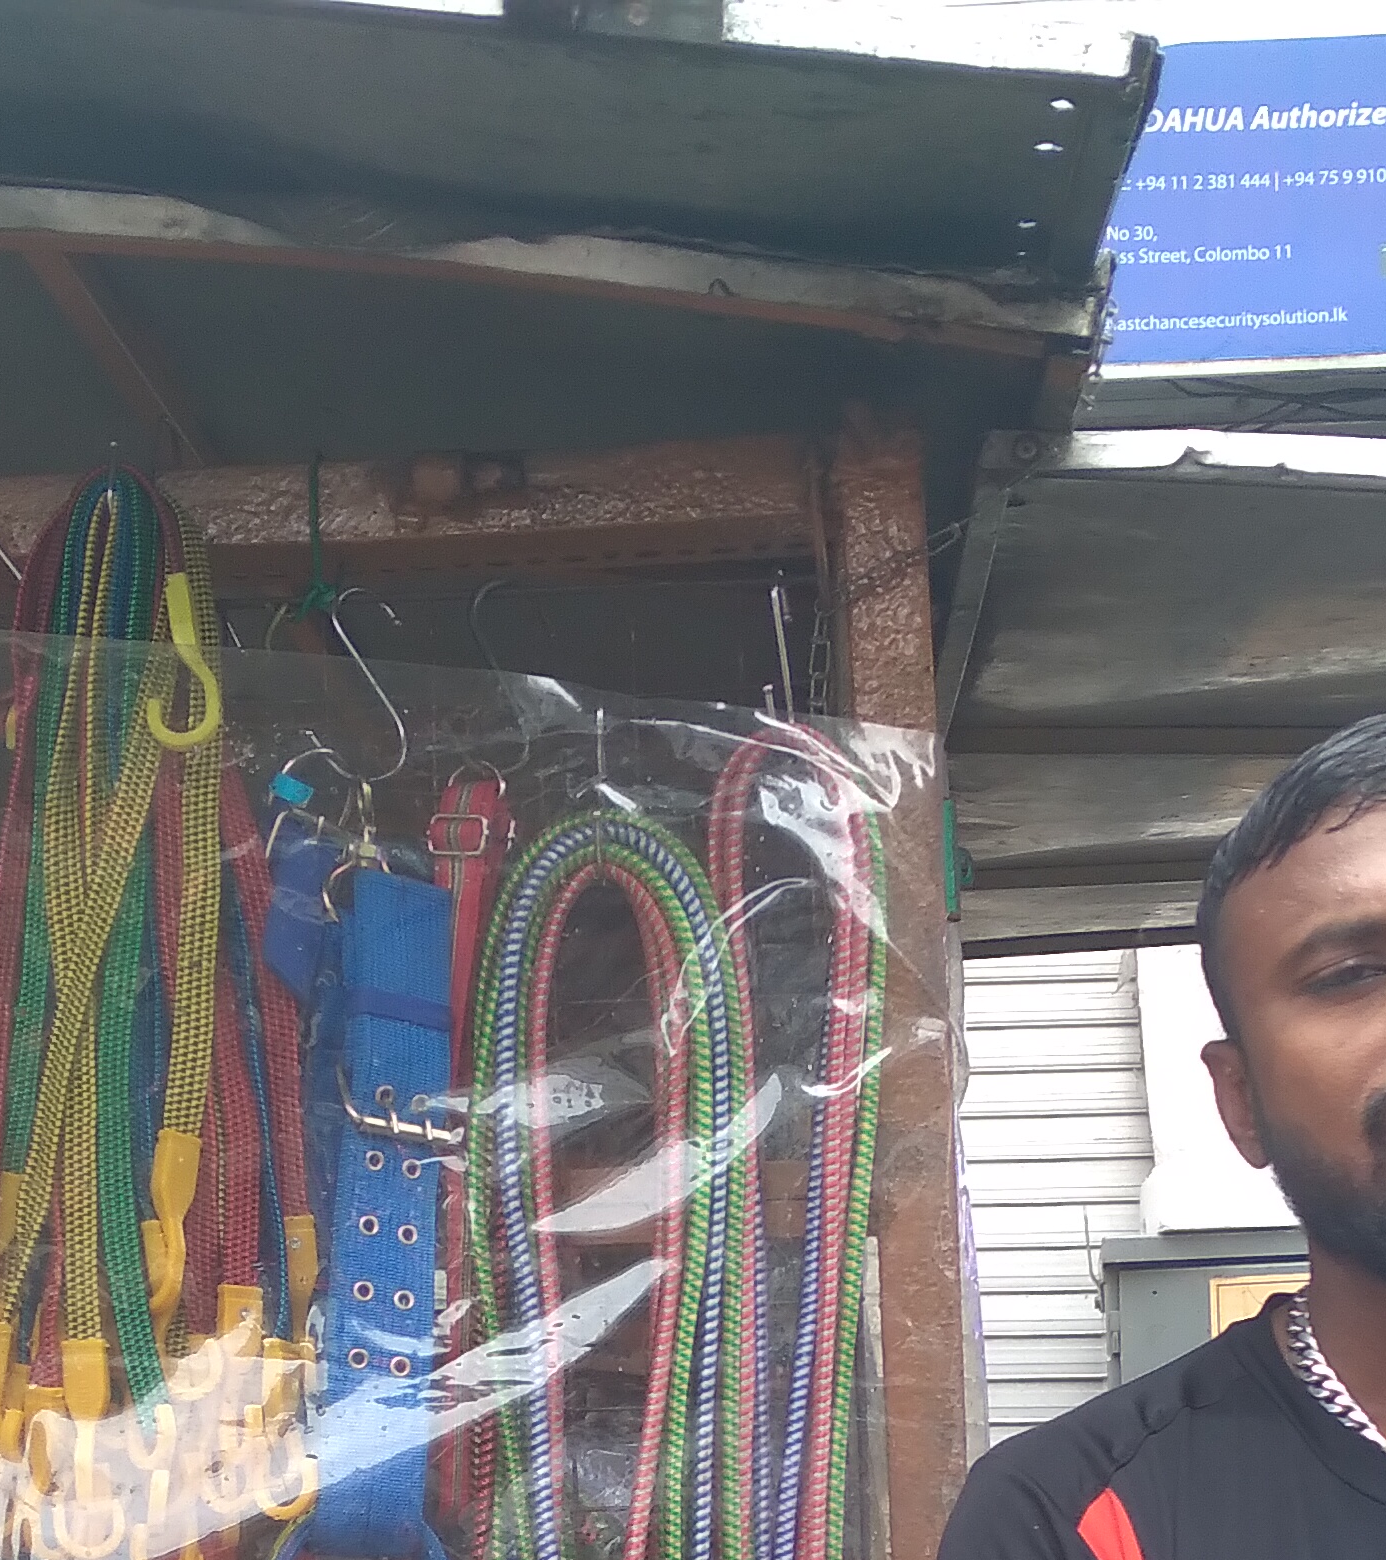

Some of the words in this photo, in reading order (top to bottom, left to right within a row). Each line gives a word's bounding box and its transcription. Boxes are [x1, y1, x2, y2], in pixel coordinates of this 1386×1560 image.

[1144, 106, 1245, 133] DAHUA
[1135, 175, 1166, 191] +94
[1171, 175, 1188, 190] 11
[1193, 175, 1203, 190] 2
[1207, 174, 1235, 190] 381
[1240, 173, 1271, 188] 444
[1283, 171, 1315, 187] +94
[1318, 169, 1339, 185] 75
[1342, 169, 1353, 185] 9
[1106, 225, 1130, 241] No
[1133, 225, 1159, 243] 30,
[1138, 247, 1192, 266] Street,
[1194, 244, 1270, 264] Colombo
[1274, 243, 1292, 260] 11
[1113, 306, 1349, 332] astchancesecuritysolution.lk
